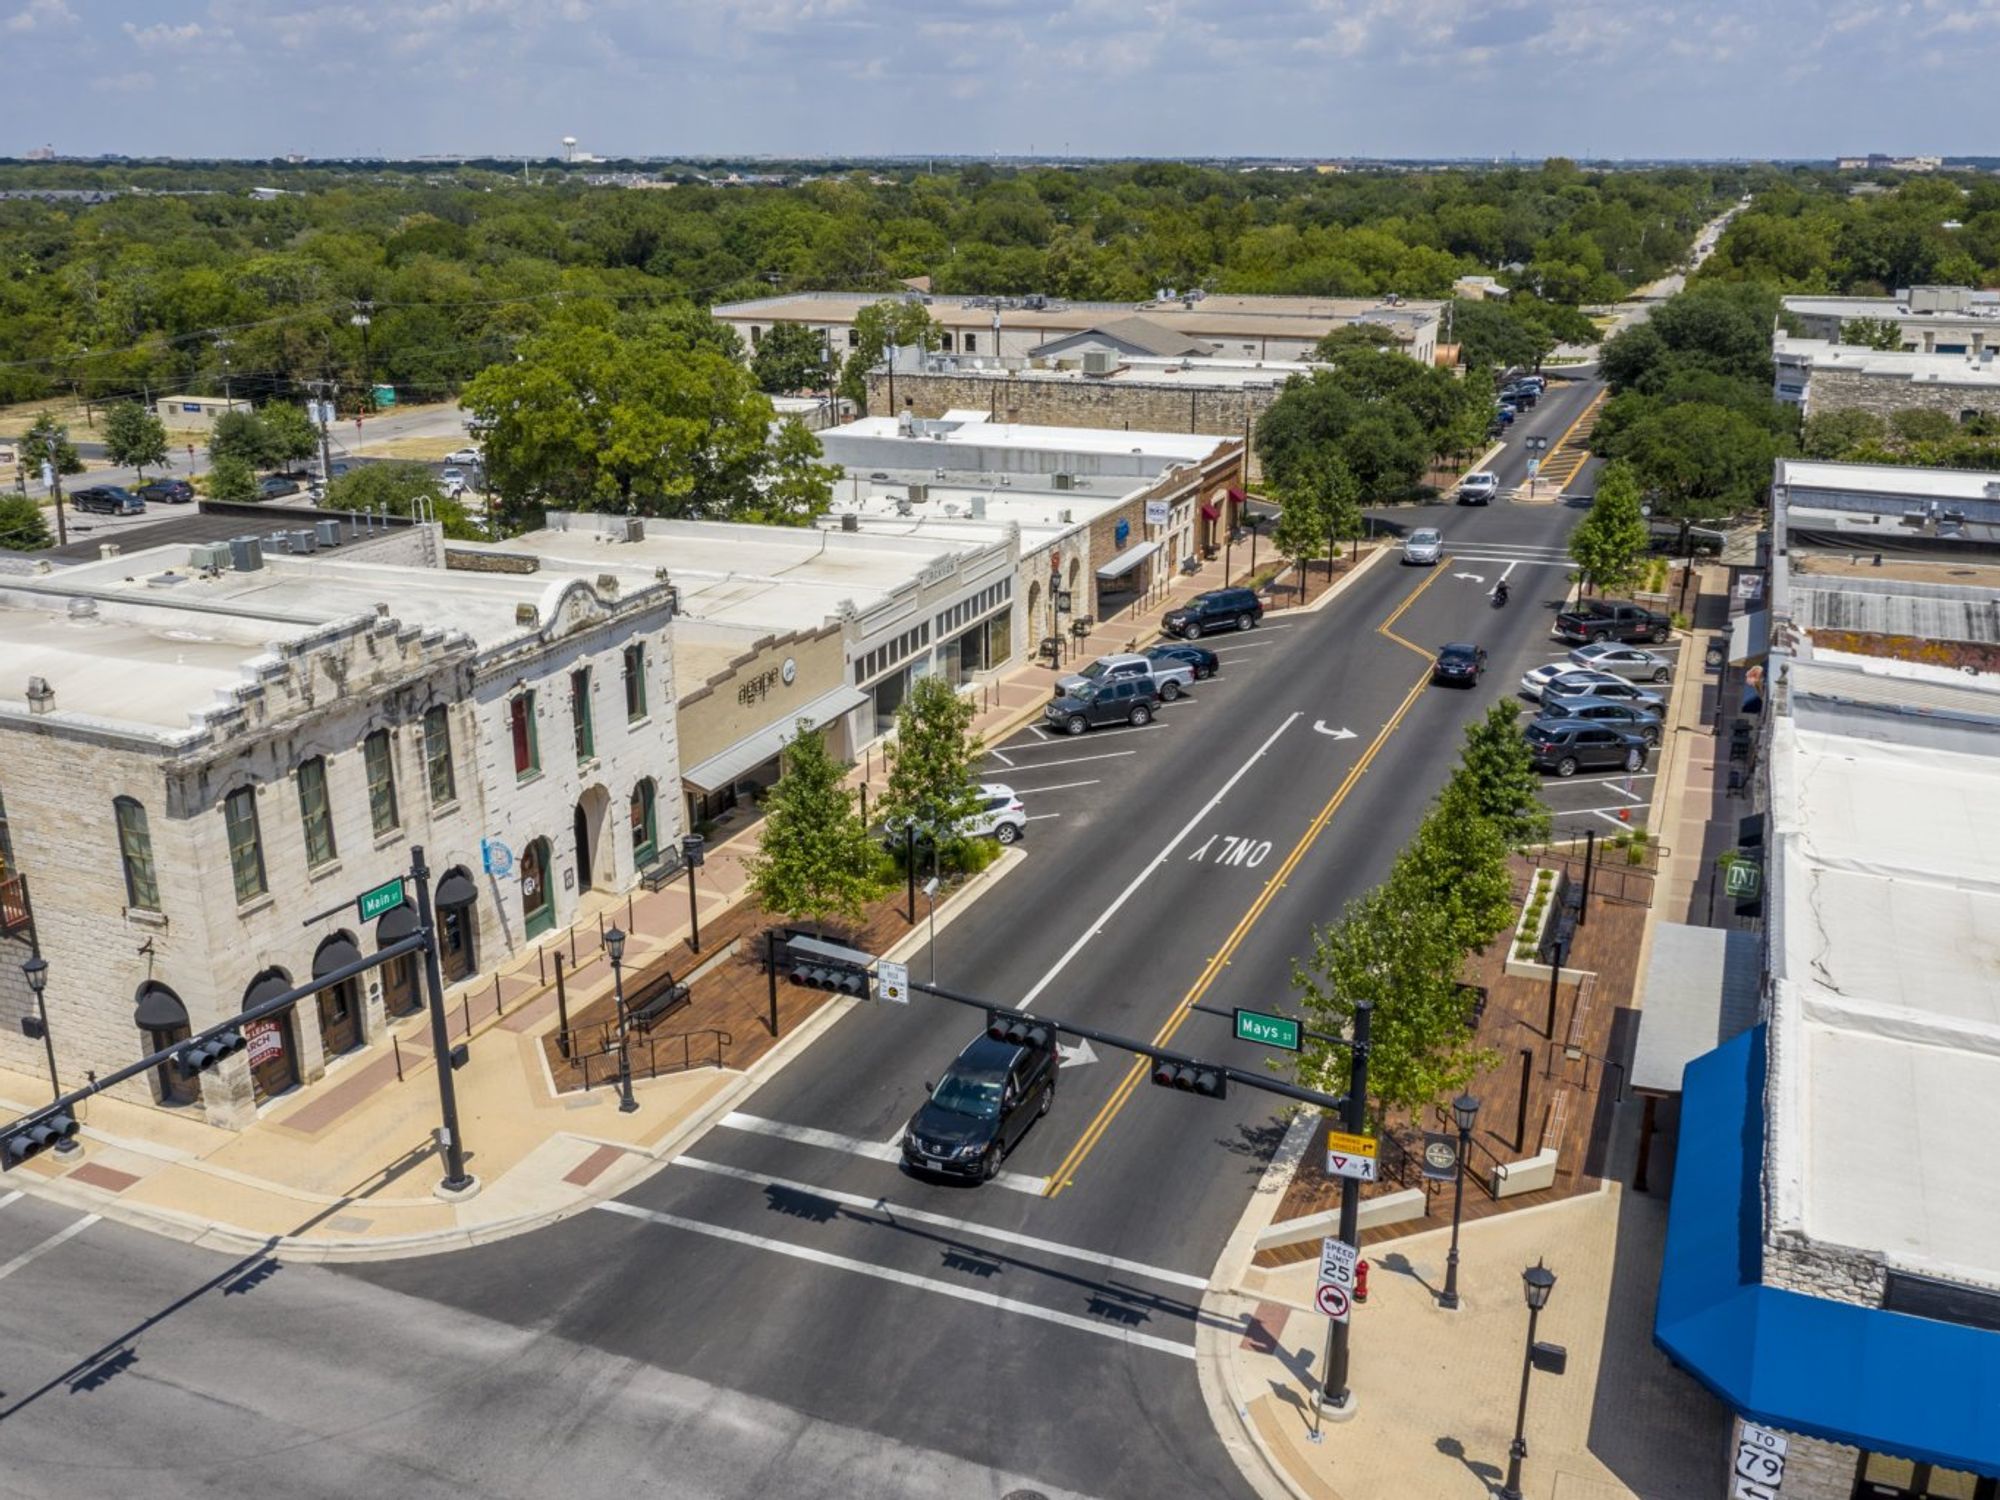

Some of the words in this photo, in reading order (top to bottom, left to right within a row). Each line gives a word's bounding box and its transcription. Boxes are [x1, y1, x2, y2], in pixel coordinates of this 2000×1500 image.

[738, 667, 779, 707] agape
[1187, 834, 1273, 868] ONLY
[1731, 866, 1758, 886] TNT
[366, 893, 390, 912] Main
[252, 1022, 275, 1036] LEASE
[1243, 1018, 1279, 1038] Mays
[1325, 1242, 1354, 1260] SPEED
[1326, 1252, 1350, 1266] LIMIT
[1323, 1261, 1350, 1283] 25
[1754, 1430, 1776, 1447] TO
[1743, 1449, 1779, 1478] 79
